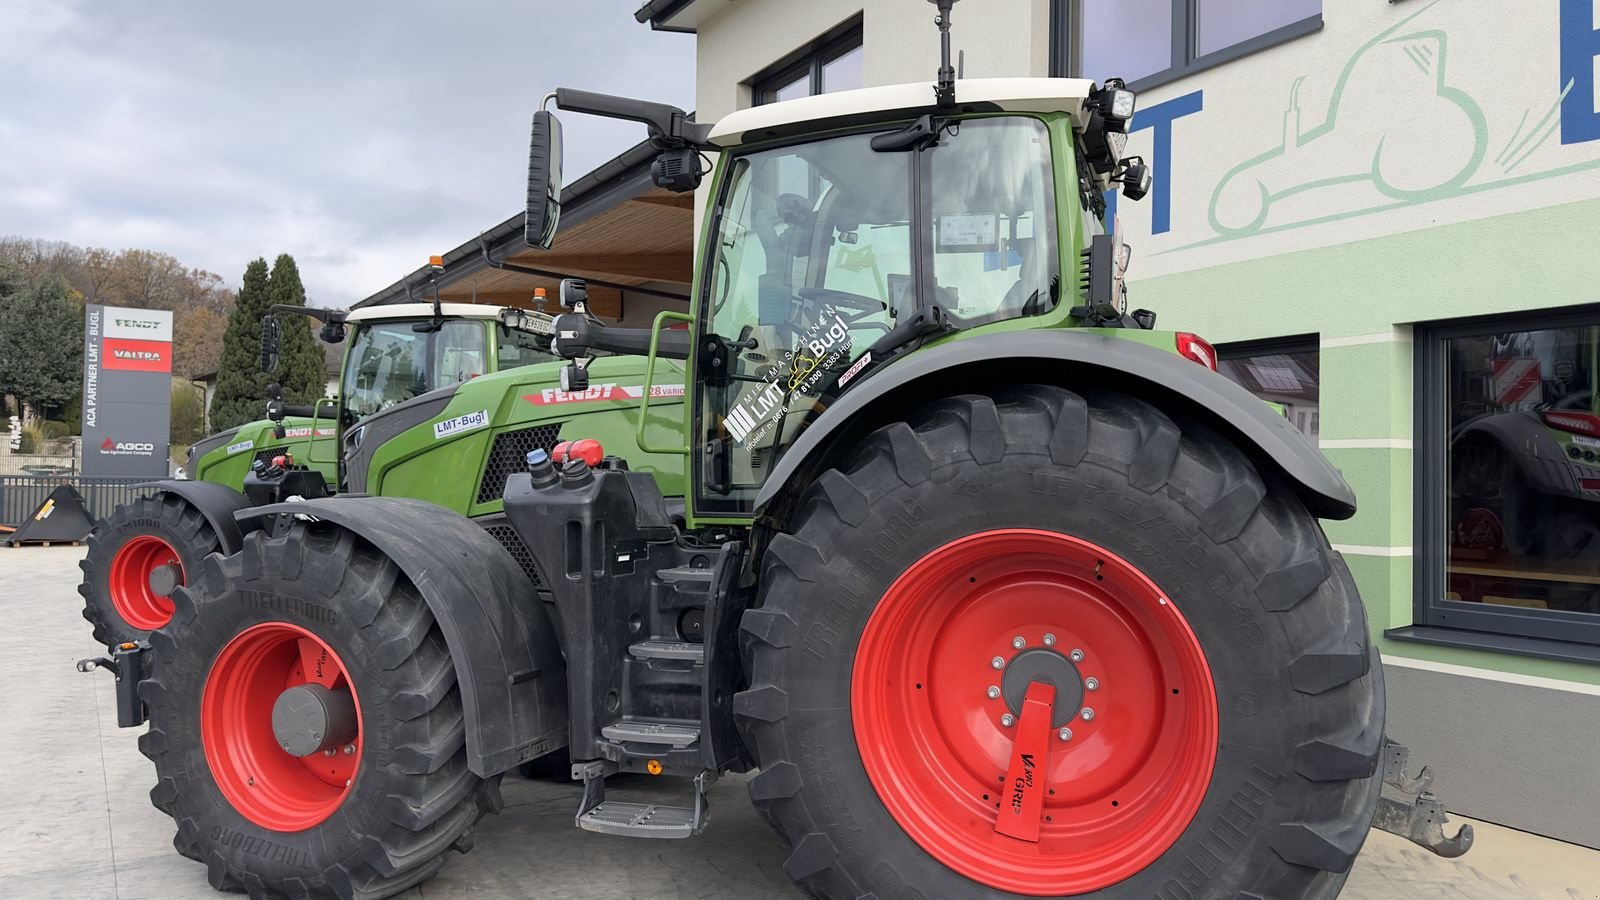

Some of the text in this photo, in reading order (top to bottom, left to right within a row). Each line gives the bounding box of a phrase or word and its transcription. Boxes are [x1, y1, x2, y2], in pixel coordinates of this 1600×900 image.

[90, 310, 99, 336] BUGL
[115, 318, 162, 329] FENDT
[89, 343, 98, 362] LMT
[114, 350, 161, 362] VALTRA
[743, 304, 836, 405] MIETMASCHINEN
[751, 315, 849, 420] LMT Bugl
[801, 383, 811, 393] 81
[810, 371, 823, 385] 300
[823, 353, 840, 370] 3383
[87, 364, 98, 406] PARTNER
[541, 383, 616, 403] FENDT
[86, 408, 96, 427] ACA
[437, 411, 485, 433] LMT-Bugl
[116, 442, 154, 451] AGCO
[238, 589, 338, 627] TRELLEBORG
